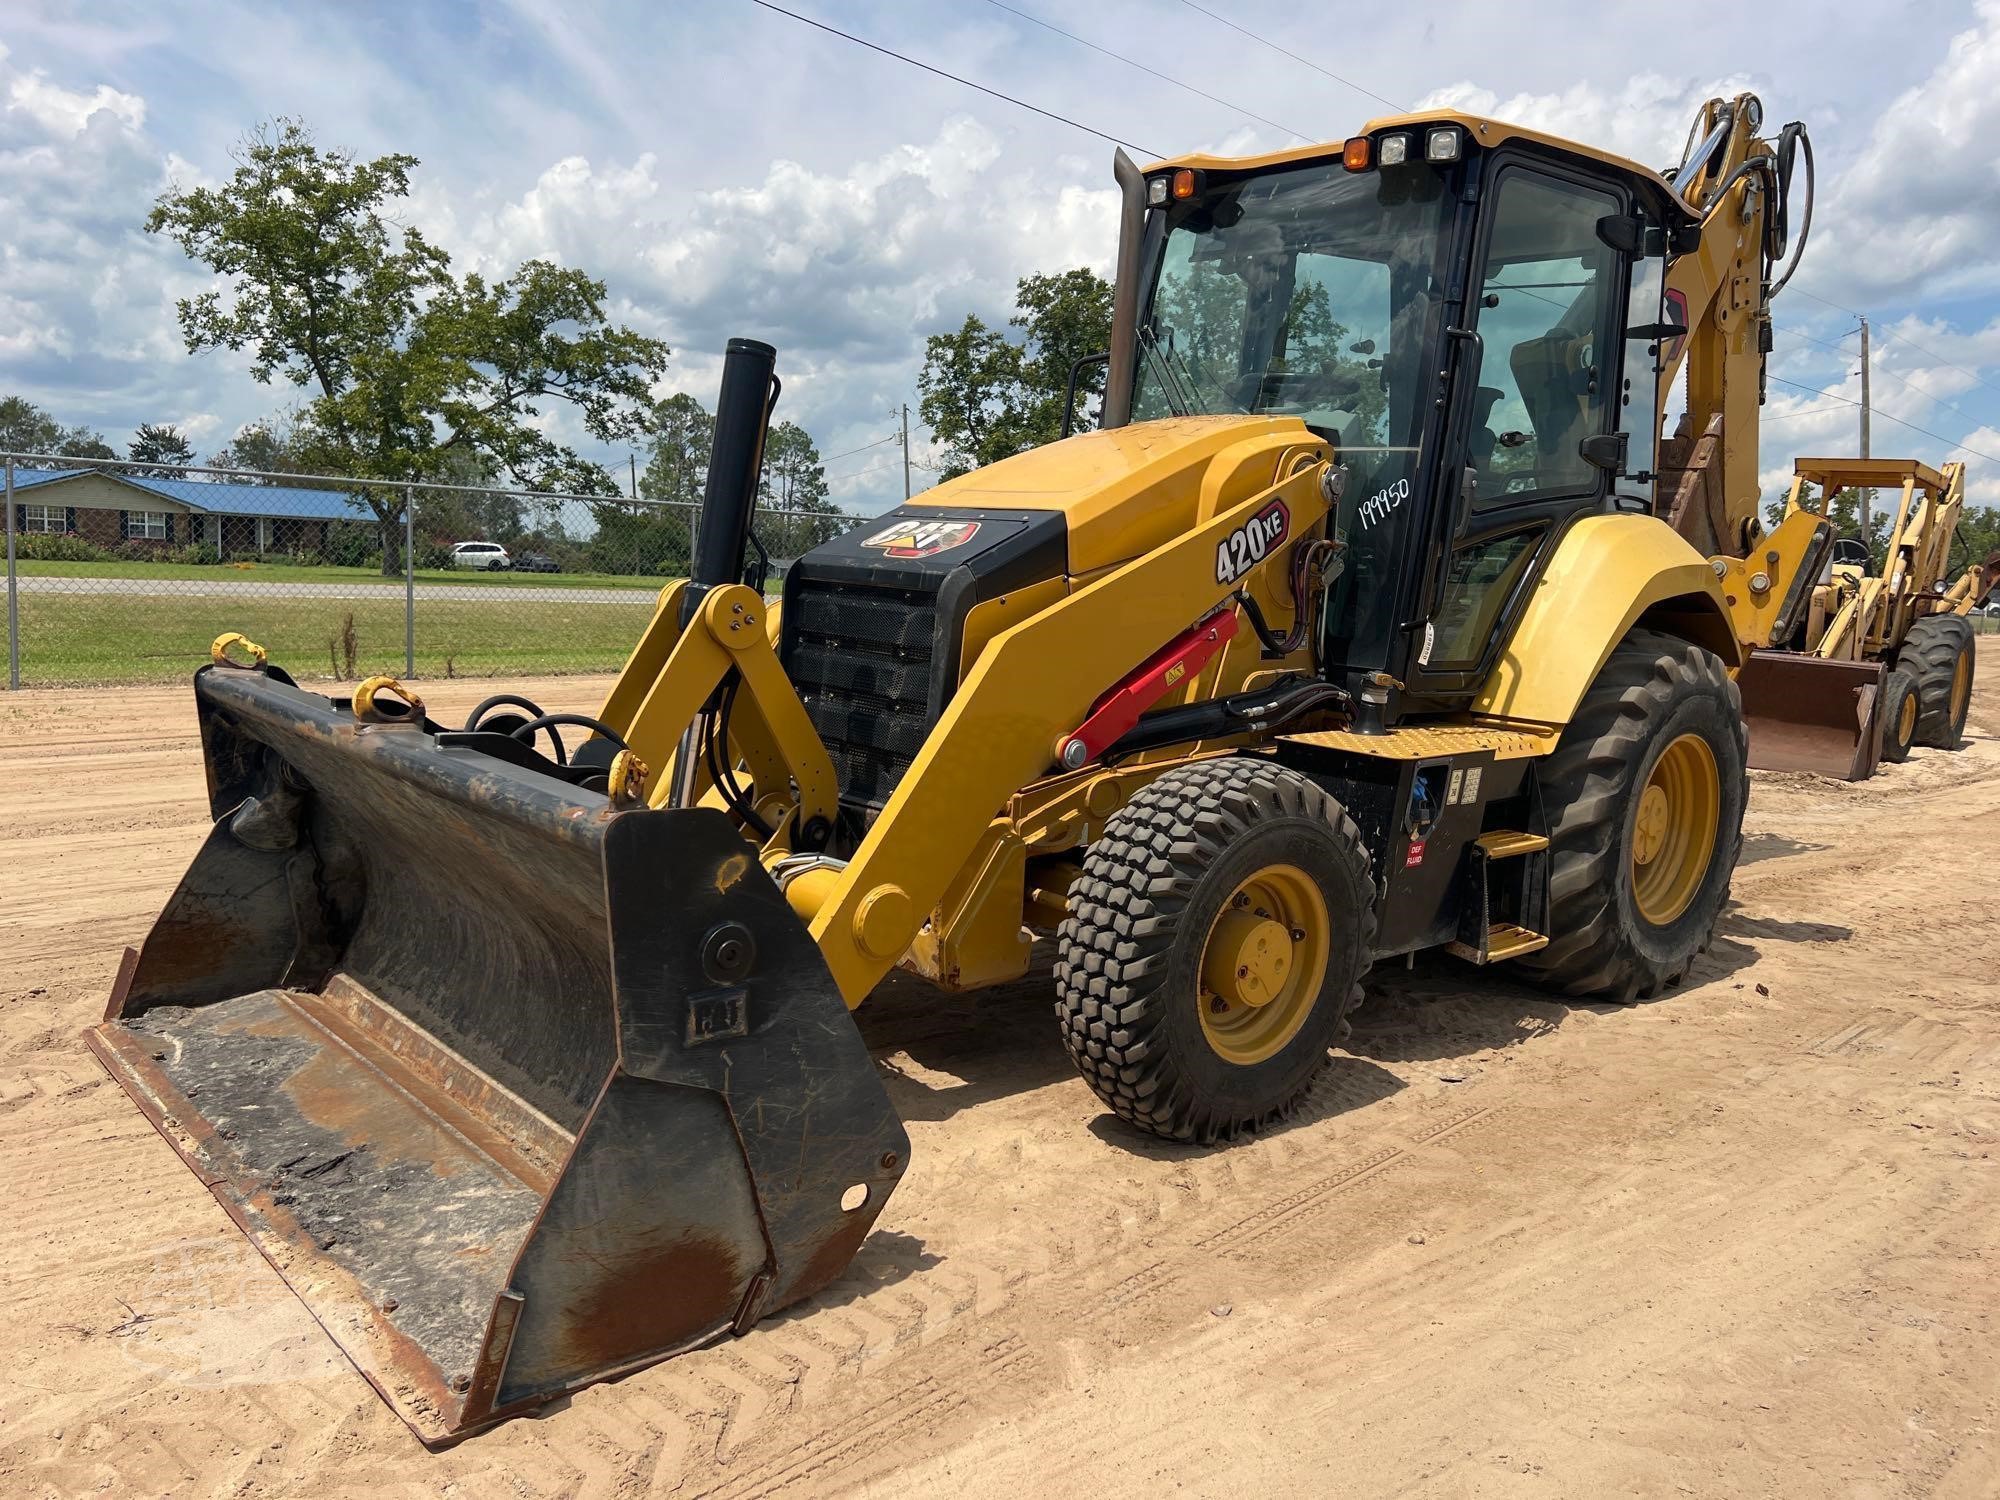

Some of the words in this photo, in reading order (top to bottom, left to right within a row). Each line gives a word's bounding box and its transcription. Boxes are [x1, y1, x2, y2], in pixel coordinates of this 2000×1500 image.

[1358, 478, 1409, 530] 199950
[865, 520, 970, 549] CAT
[1411, 845, 1422, 854] DEF
[1407, 855, 1422, 865] FLUID
